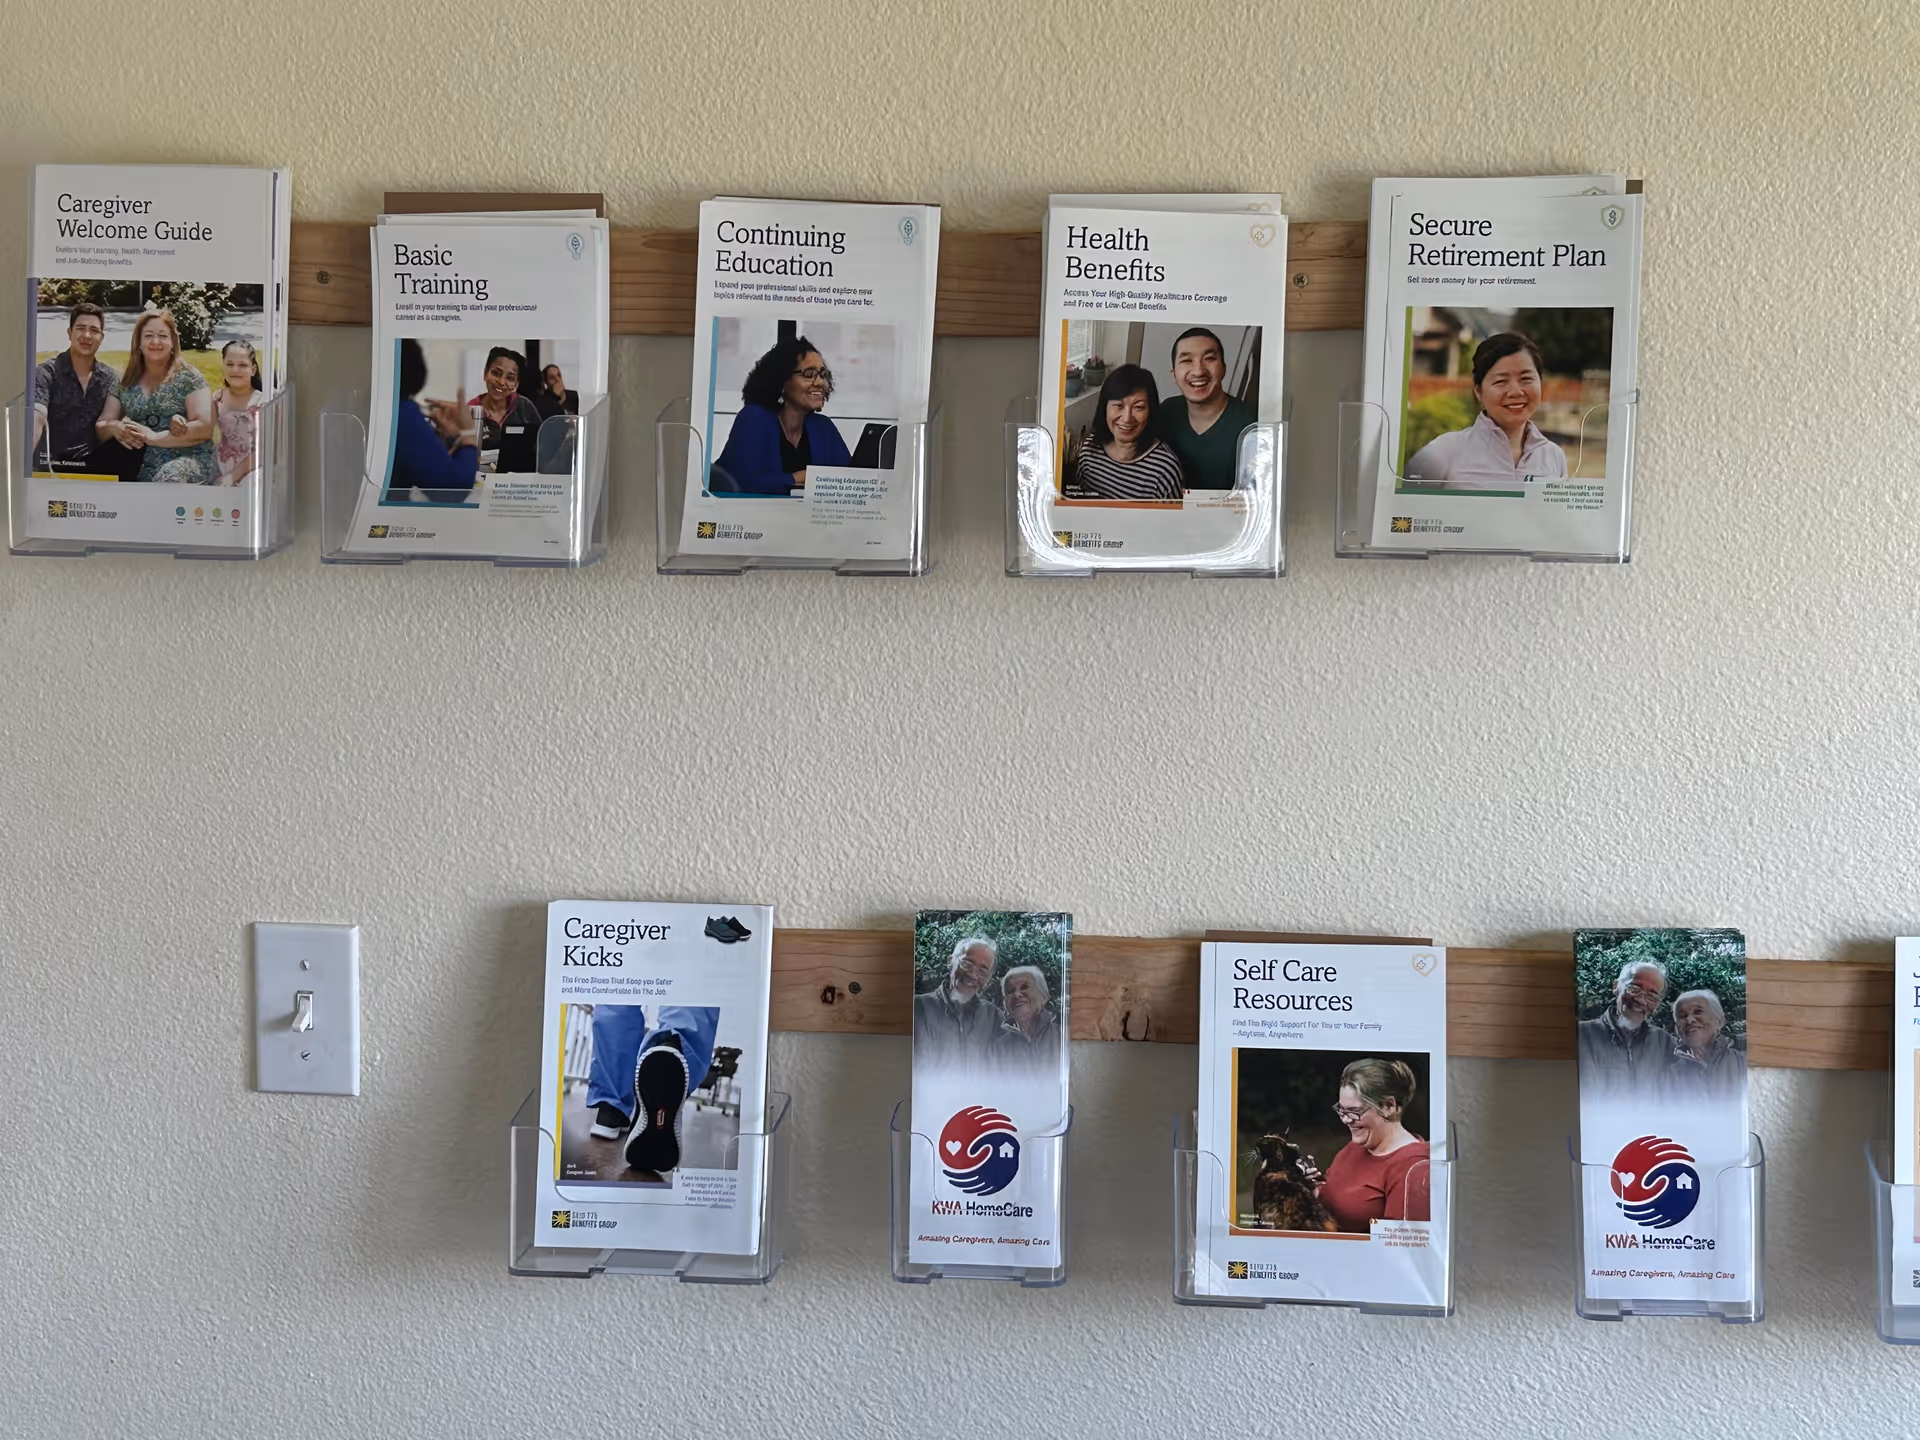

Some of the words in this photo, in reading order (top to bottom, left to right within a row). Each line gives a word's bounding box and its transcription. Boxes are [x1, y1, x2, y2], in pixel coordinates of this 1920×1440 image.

[57, 193, 152, 218] Caregiver
[57, 218, 148, 240] Welcome
[154, 220, 213, 241] Guide
[1409, 212, 1492, 236] Secure
[717, 220, 846, 254] Continuing
[1066, 226, 1149, 251] Health
[394, 243, 453, 266] Basic
[715, 250, 834, 277] Education
[1408, 243, 1545, 267] Retirement
[1552, 244, 1606, 267] Plan
[1065, 255, 1165, 282] Benefits
[394, 273, 489, 301] Training
[740, 282, 754, 290] your
[756, 283, 797, 292] professional
[818, 285, 831, 293] and
[832, 286, 857, 295] explore
[1467, 276, 1477, 284] for
[1480, 277, 1495, 286] your
[422, 304, 435, 312] your
[437, 303, 460, 312] training
[713, 291, 735, 300] topics
[772, 293, 783, 301] the
[784, 294, 804, 303] needs
[806, 295, 813, 303] of
[814, 296, 832, 304] those
[833, 297, 846, 306] you
[1063, 289, 1089, 297] Access
[1091, 289, 1107, 298] Your
[1153, 292, 1192, 301] Healthcare
[1194, 293, 1228, 304] Coverage
[1078, 300, 1093, 308] Free
[1138, 302, 1167, 310] Benefits
[564, 917, 670, 945] Caregiver
[562, 945, 623, 967] Kicks
[574, 976, 589, 984] Free
[626, 978, 641, 986] Keep
[1233, 958, 1278, 981] Self
[1283, 959, 1337, 982] Care
[1233, 987, 1353, 1012] Resources
[1279, 1021, 1307, 1029] Support
[1308, 1021, 1319, 1029] For
[932, 1200, 962, 1216] KWA
[966, 1200, 1033, 1218] HomeCare
[917, 1234, 951, 1244] Amazing
[952, 1235, 995, 1245] Caregivers,
[997, 1236, 1030, 1246] Amazing
[1032, 1237, 1050, 1246] Care
[1605, 1233, 1639, 1249] KWA
[1642, 1234, 1715, 1250] HomeCare
[1591, 1269, 1627, 1278] Amazing
[1629, 1269, 1675, 1279] Caregivers,
[1678, 1270, 1713, 1279] Amazing
[1715, 1271, 1735, 1279] Care
